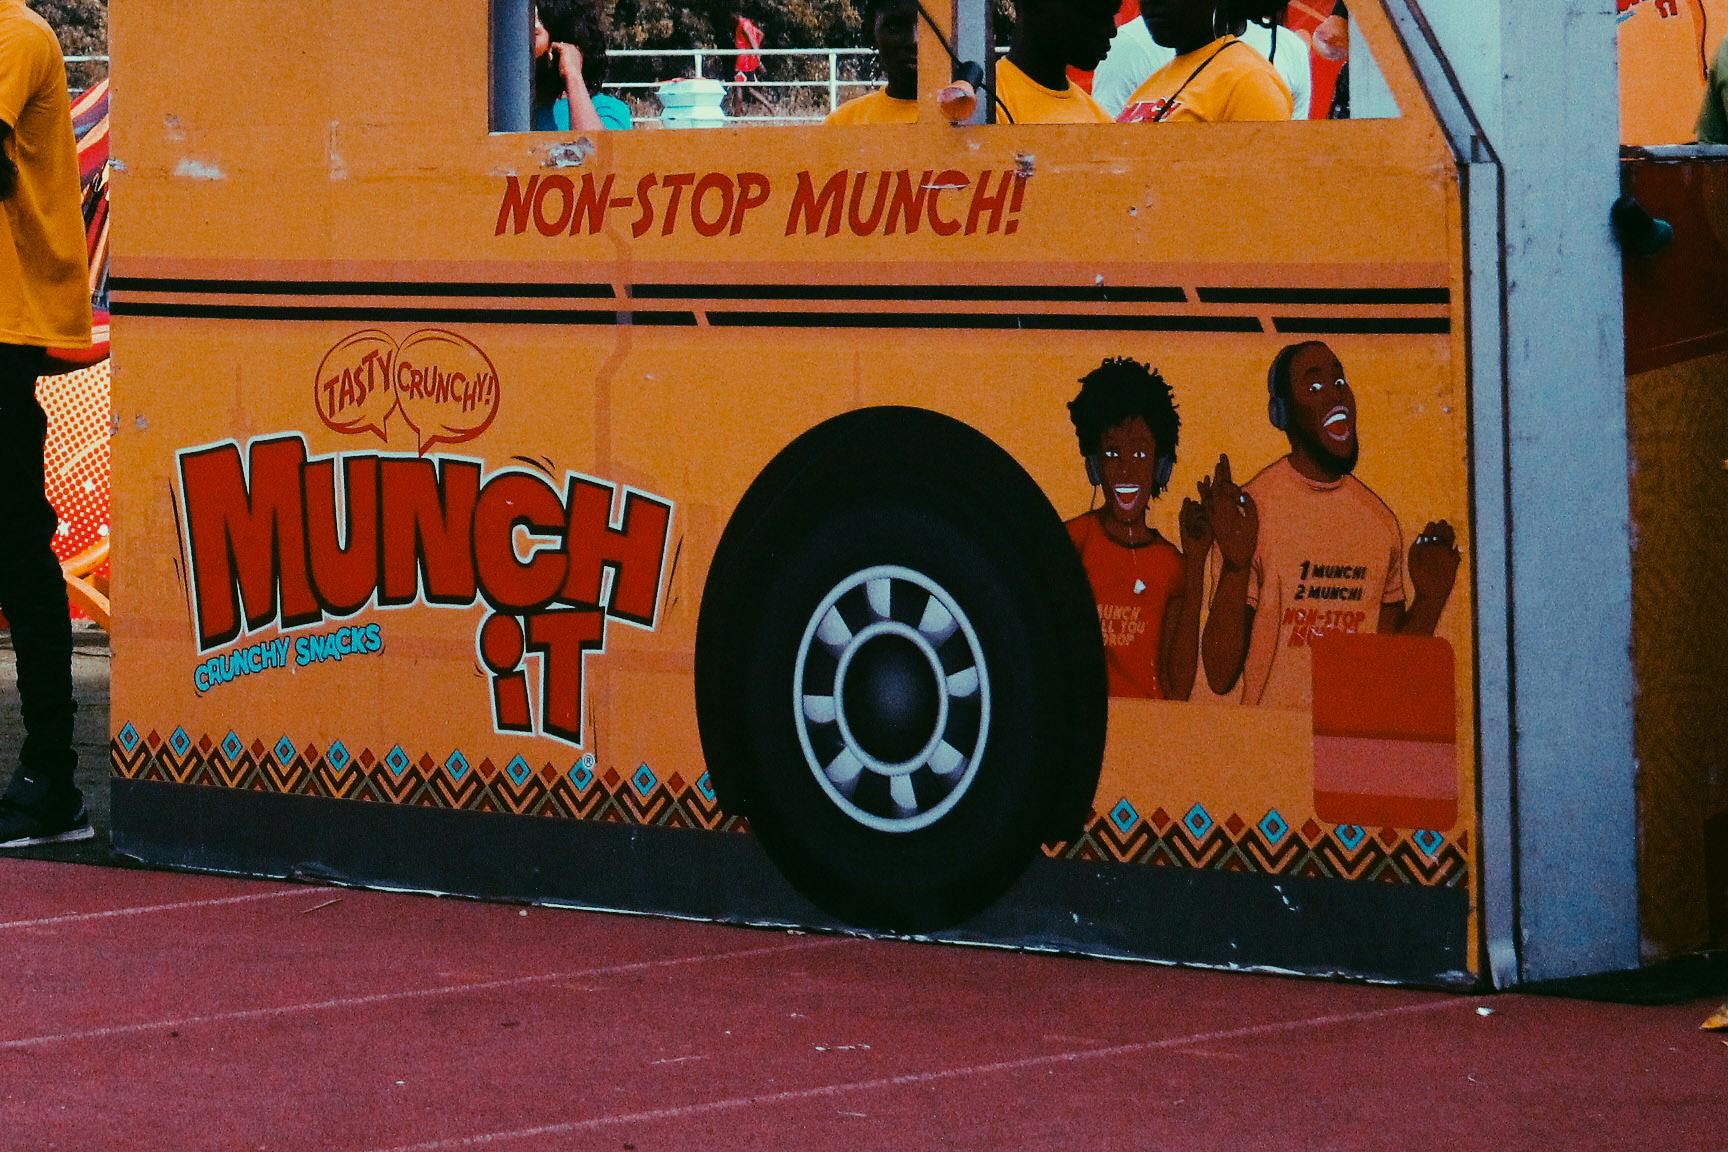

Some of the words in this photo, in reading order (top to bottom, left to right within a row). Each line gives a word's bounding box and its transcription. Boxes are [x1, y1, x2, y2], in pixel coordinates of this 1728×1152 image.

[494, 171, 771, 239] NON-STOP
[785, 169, 1029, 239] MUNCH!
[323, 349, 393, 417] TASTY
[397, 359, 495, 414] CRUNCHY!
[177, 433, 674, 654] MUNCH
[1299, 559, 1310, 581] 1
[1294, 584, 1305, 600] 2
[193, 635, 291, 693] CRUNCHY
[295, 622, 383, 666] SNACKS
[1121, 620, 1146, 634] YOU
